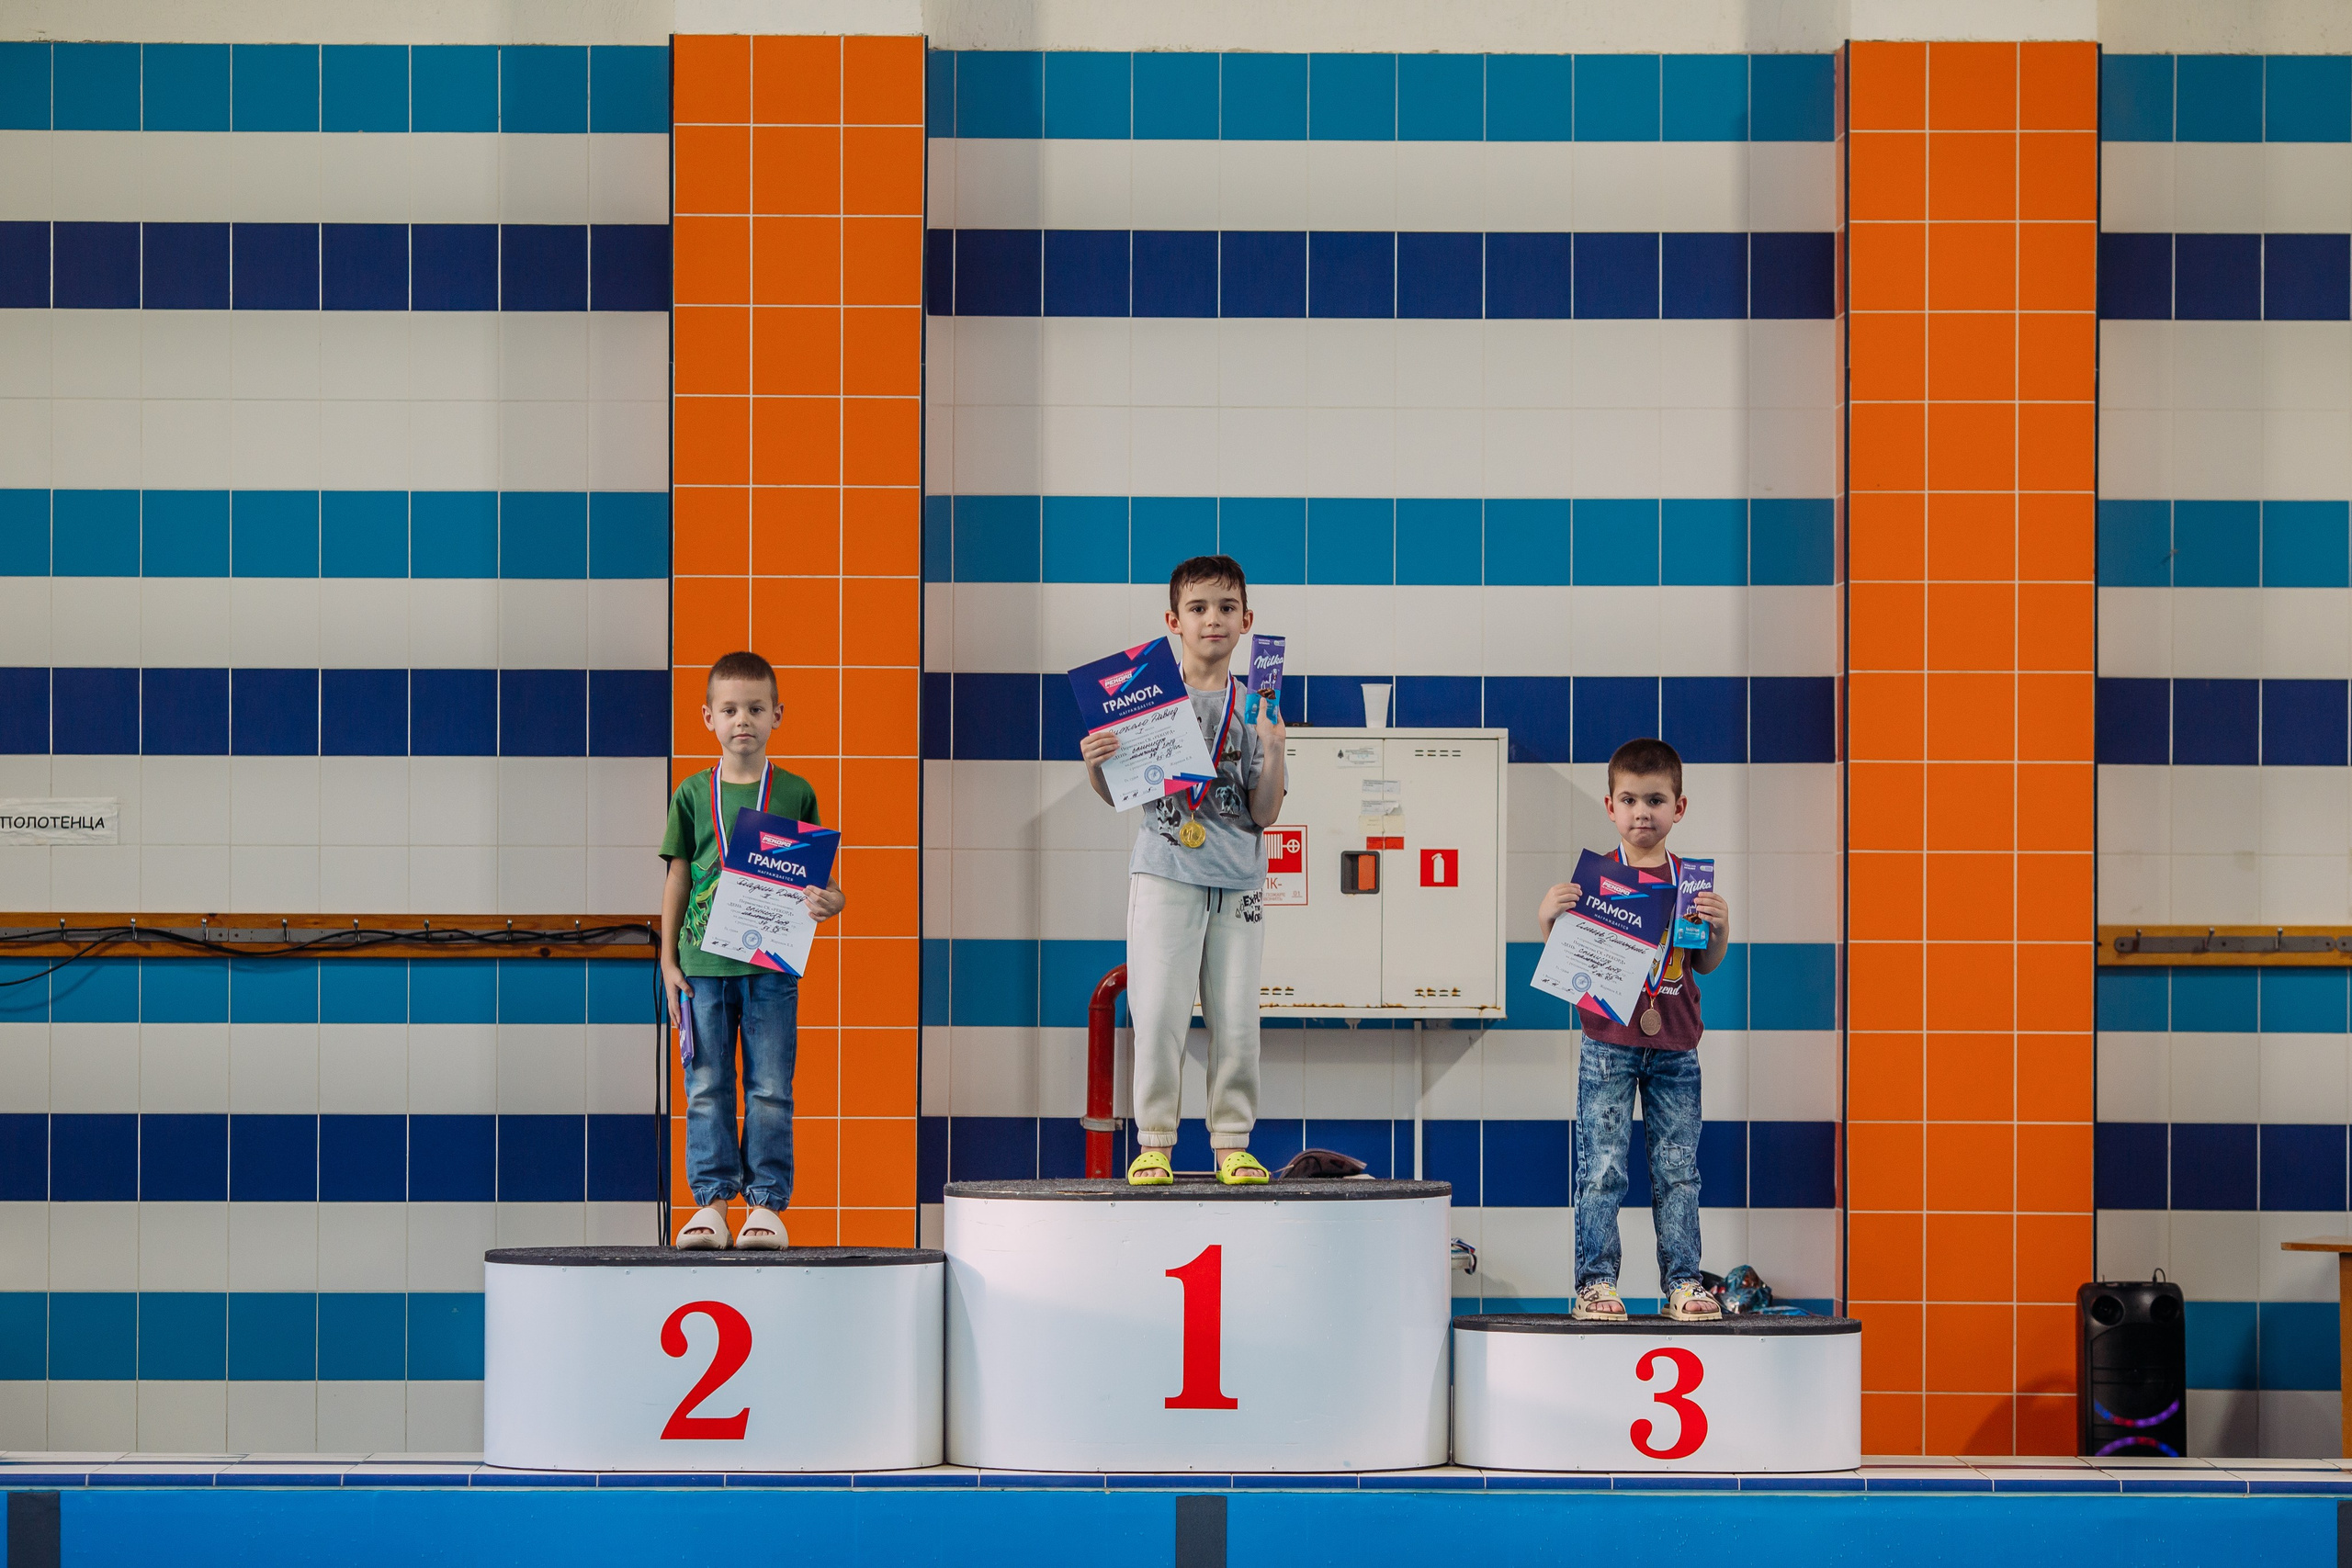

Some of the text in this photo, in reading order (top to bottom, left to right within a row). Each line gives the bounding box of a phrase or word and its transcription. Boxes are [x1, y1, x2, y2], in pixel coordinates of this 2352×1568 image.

[1254, 654, 1283, 669] Milka
[1103, 671, 1134, 687] РЕКОРД
[1102, 684, 1162, 713] ГРАМОТА
[1118, 701, 1154, 716] НАГРАЖДАЕТСЯ
[0, 816, 105, 830] ПОЛОТЕНЦА
[761, 835, 792, 848] РЕКОРД
[747, 852, 806, 877] ГРАМОТА
[757, 869, 793, 881] НАГРАЖДАЕТСЯ
[1601, 880, 1631, 897] РЕКОРД
[1679, 879, 1713, 895] Milka
[1586, 895, 1641, 928] ГРАМОТА
[1594, 913, 1628, 930] НАГРАЖДАЕТСЯ
[1165, 1246, 1238, 1409] 1
[661, 1302, 752, 1439] 2
[1631, 1348, 1707, 1459] 3
